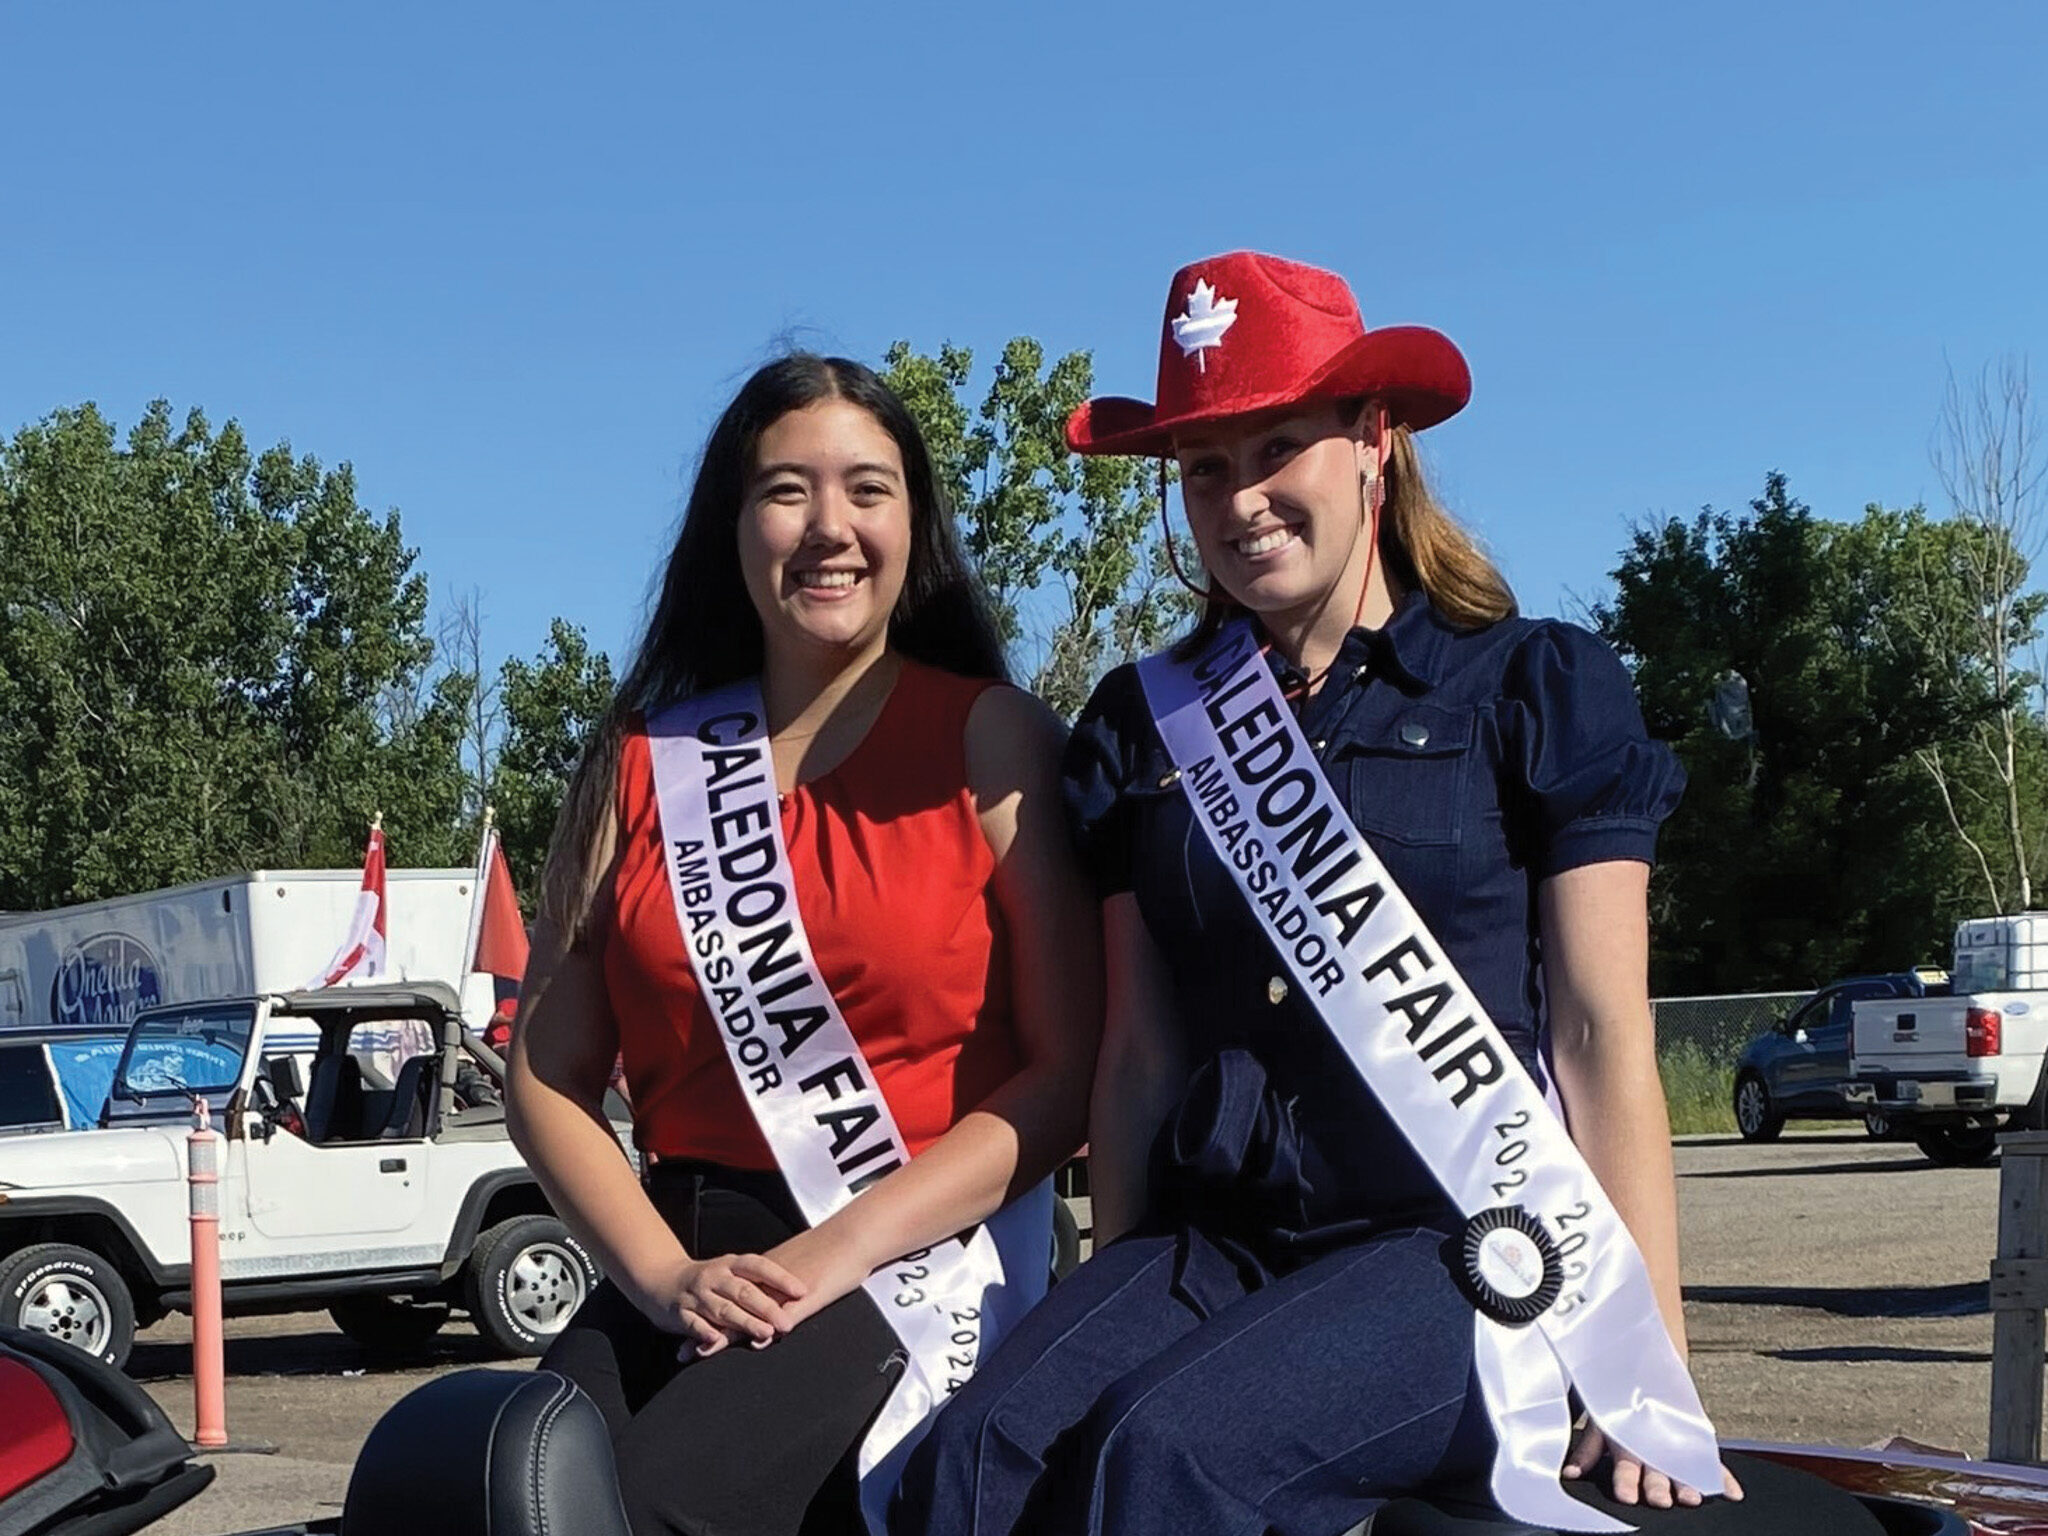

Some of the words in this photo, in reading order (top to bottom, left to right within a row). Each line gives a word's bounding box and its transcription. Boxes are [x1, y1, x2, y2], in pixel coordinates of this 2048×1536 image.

[59, 940, 141, 1014] Oneida
[674, 840, 783, 1096] AMBASSADOR
[698, 712, 830, 1058] CALEDONIA
[1187, 755, 1345, 998] AMBASSADOR
[1193, 634, 1385, 948] CALEDONIA
[1362, 935, 1502, 1109] FAIR
[218, 1231, 246, 1242] eep
[1491, 1110, 1530, 1198] 202
